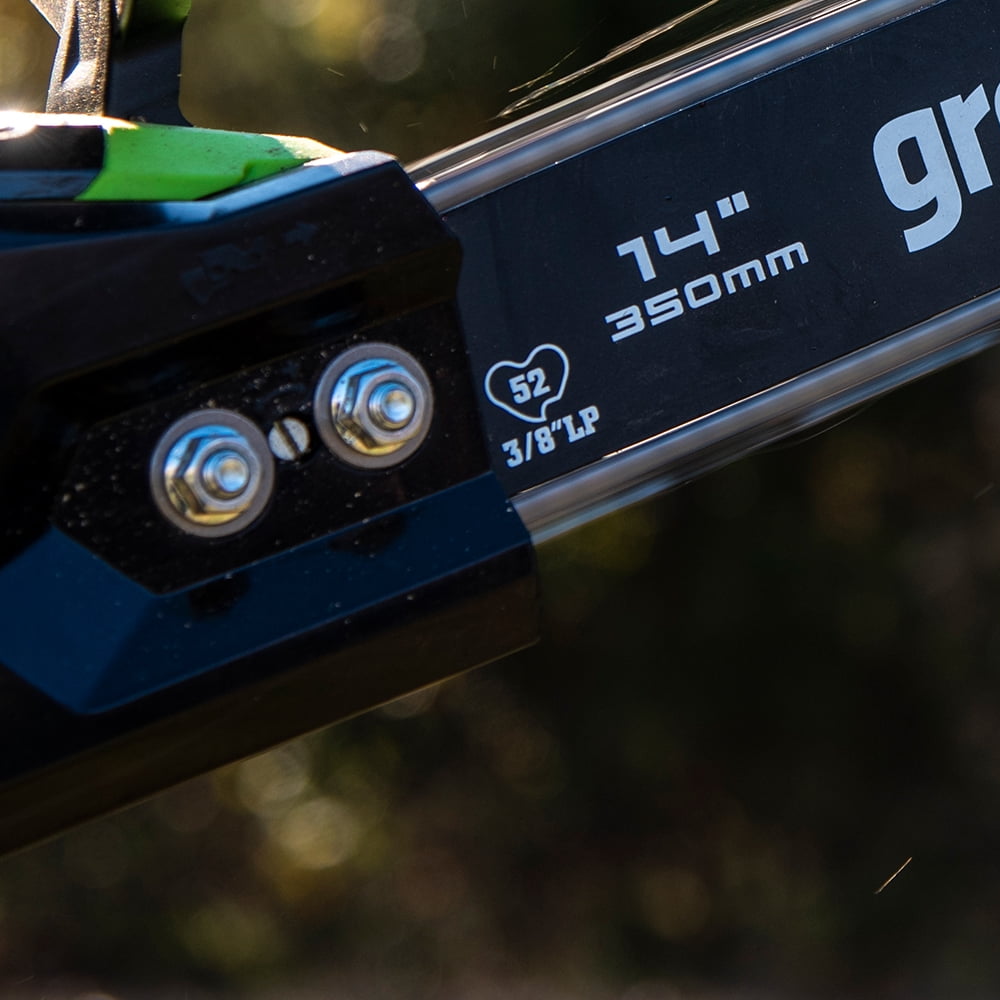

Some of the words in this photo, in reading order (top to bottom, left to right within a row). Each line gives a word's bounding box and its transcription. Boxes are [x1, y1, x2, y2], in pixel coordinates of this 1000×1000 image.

[616, 190, 750, 283] 14"
[604, 241, 809, 343] 350mm
[508, 367, 551, 404] 52
